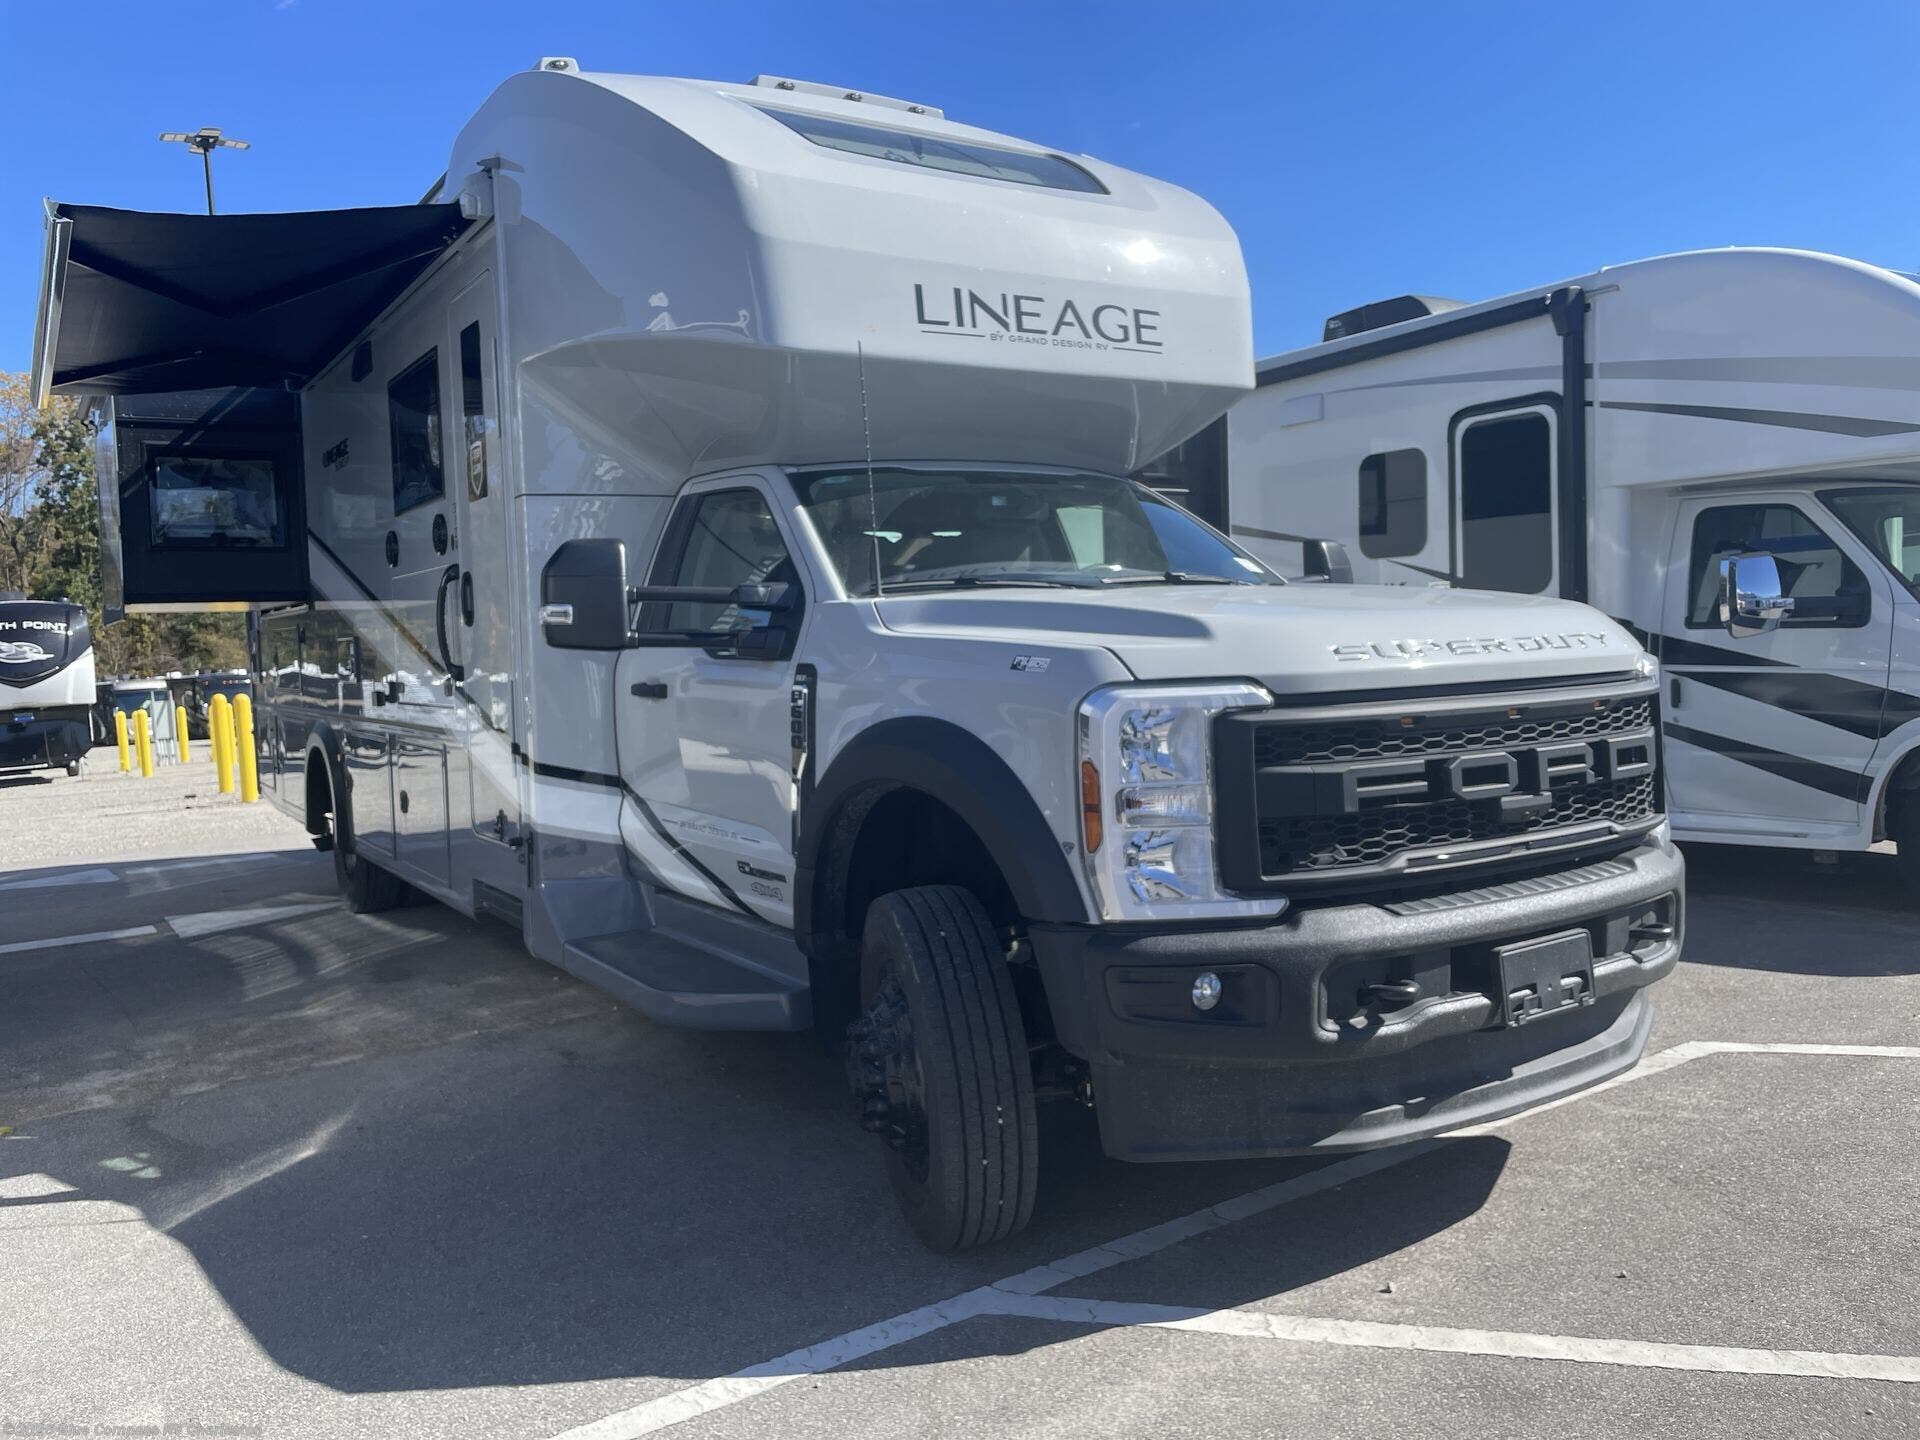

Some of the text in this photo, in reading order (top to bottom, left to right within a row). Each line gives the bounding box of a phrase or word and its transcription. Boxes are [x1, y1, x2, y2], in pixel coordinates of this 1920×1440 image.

[914, 283, 1163, 346] LINEAGE
[990, 333, 1109, 351] BY GRAND DESIGN RV
[22, 621, 67, 631] POINT
[1343, 735, 1656, 812] FORD
